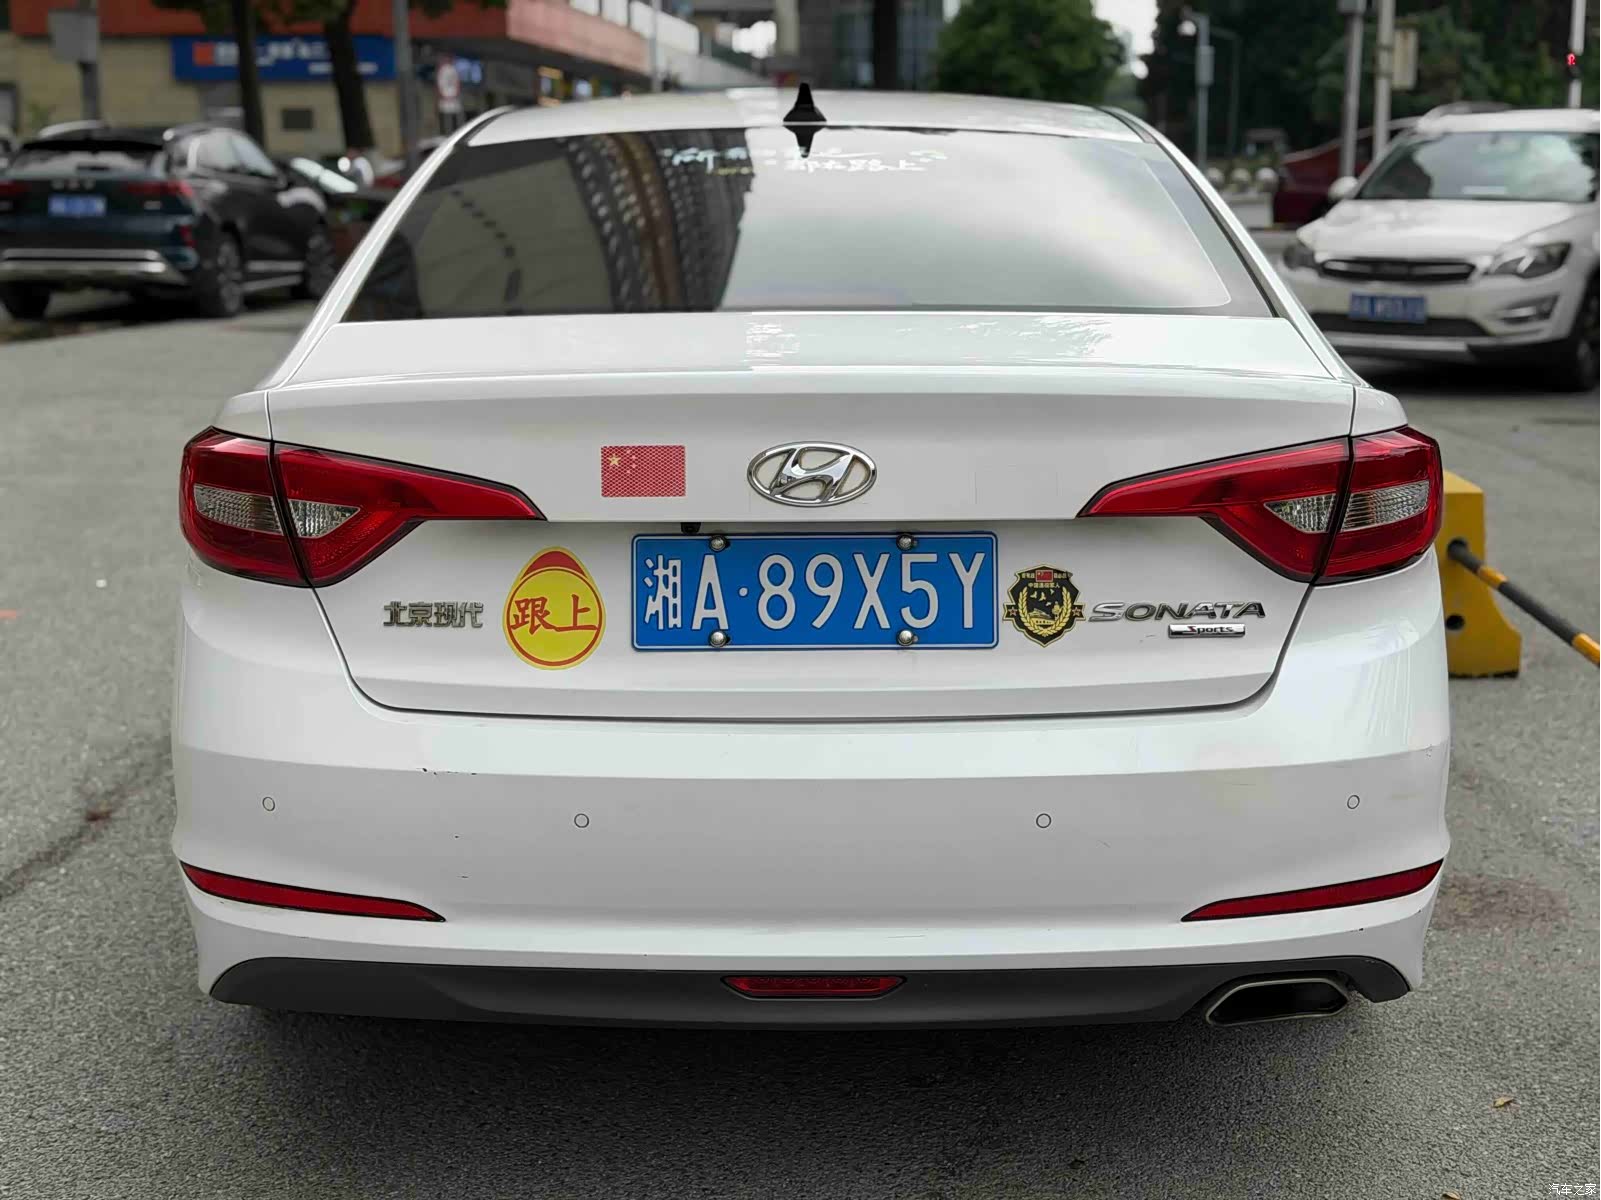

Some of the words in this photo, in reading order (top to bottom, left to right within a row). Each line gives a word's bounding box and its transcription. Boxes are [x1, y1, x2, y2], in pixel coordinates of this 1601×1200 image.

[383, 601, 484, 628] 北京现代
[510, 594, 598, 635] 跟上
[1089, 602, 1266, 622] SONATA
[1186, 625, 1234, 635] Sports
